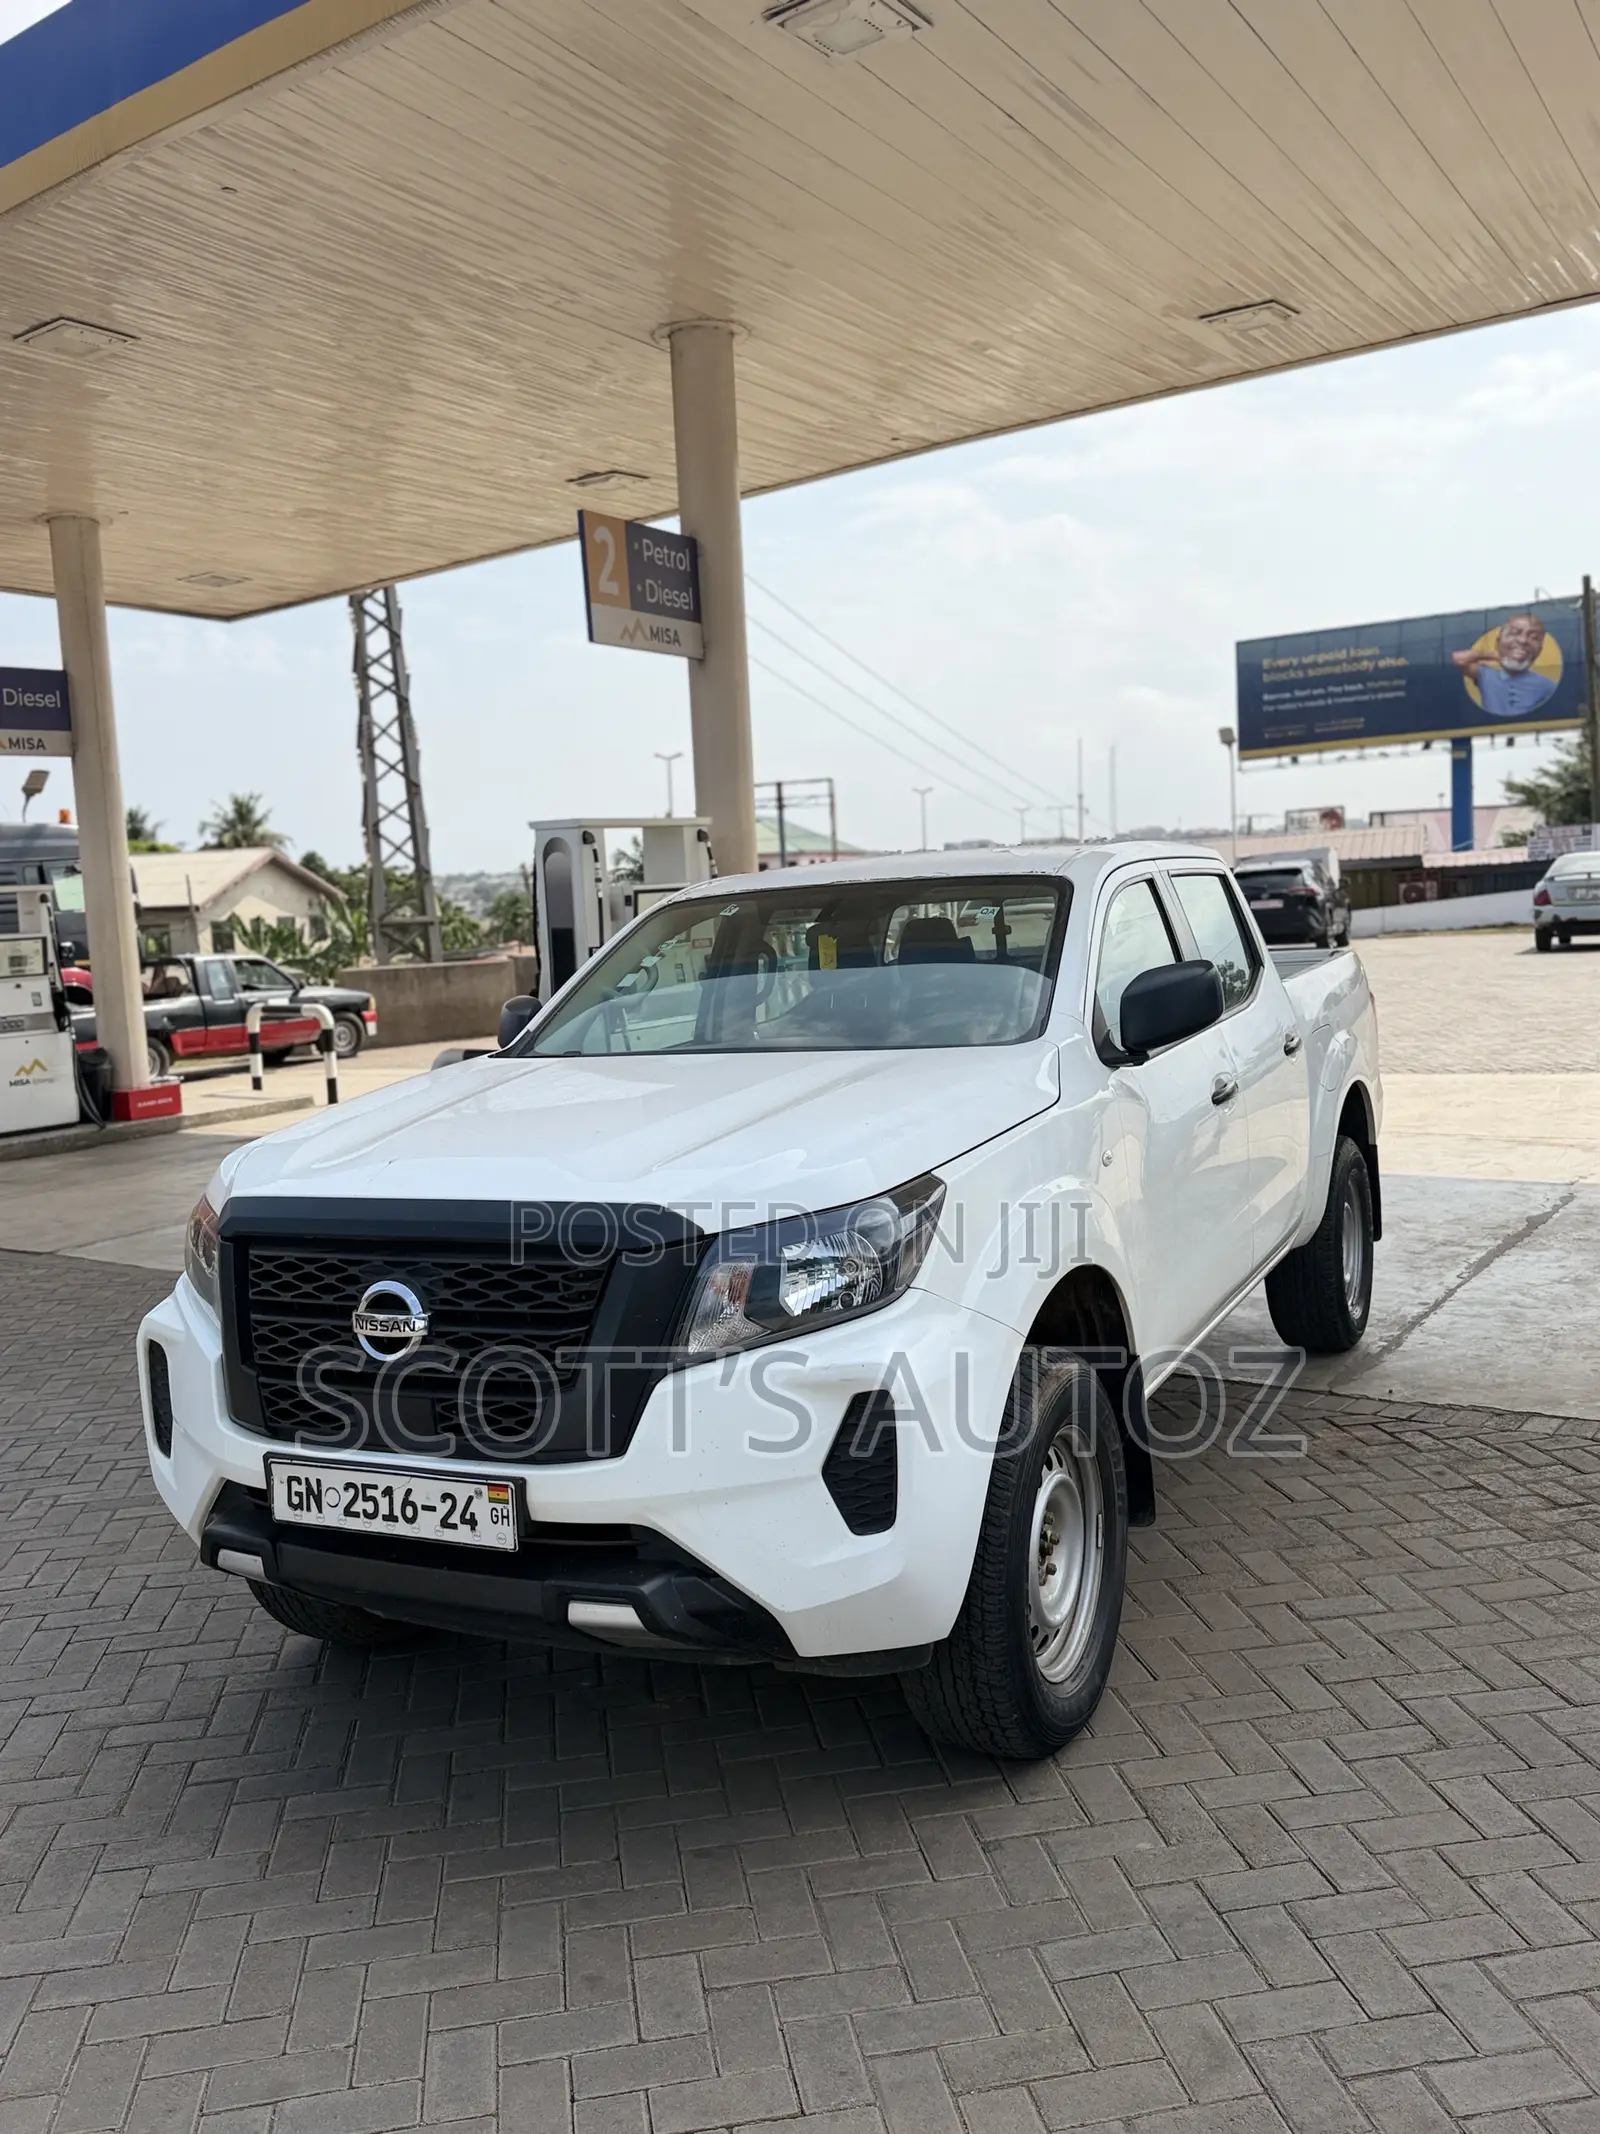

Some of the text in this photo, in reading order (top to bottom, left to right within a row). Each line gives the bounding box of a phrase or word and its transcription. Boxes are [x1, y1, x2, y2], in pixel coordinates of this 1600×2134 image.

[593, 525, 619, 596] 2
[642, 538, 691, 572] Petrol
[645, 578, 693, 611] Diesel
[649, 625, 682, 647] MISA
[2, 687, 61, 708] Diesel
[8, 737, 47, 751] MISA
[9, 1078, 31, 1088] MISA
[355, 1318, 416, 1332] NISSAN
[286, 1475, 478, 1532] GN 2516-24
[490, 1506, 511, 1527] GH
